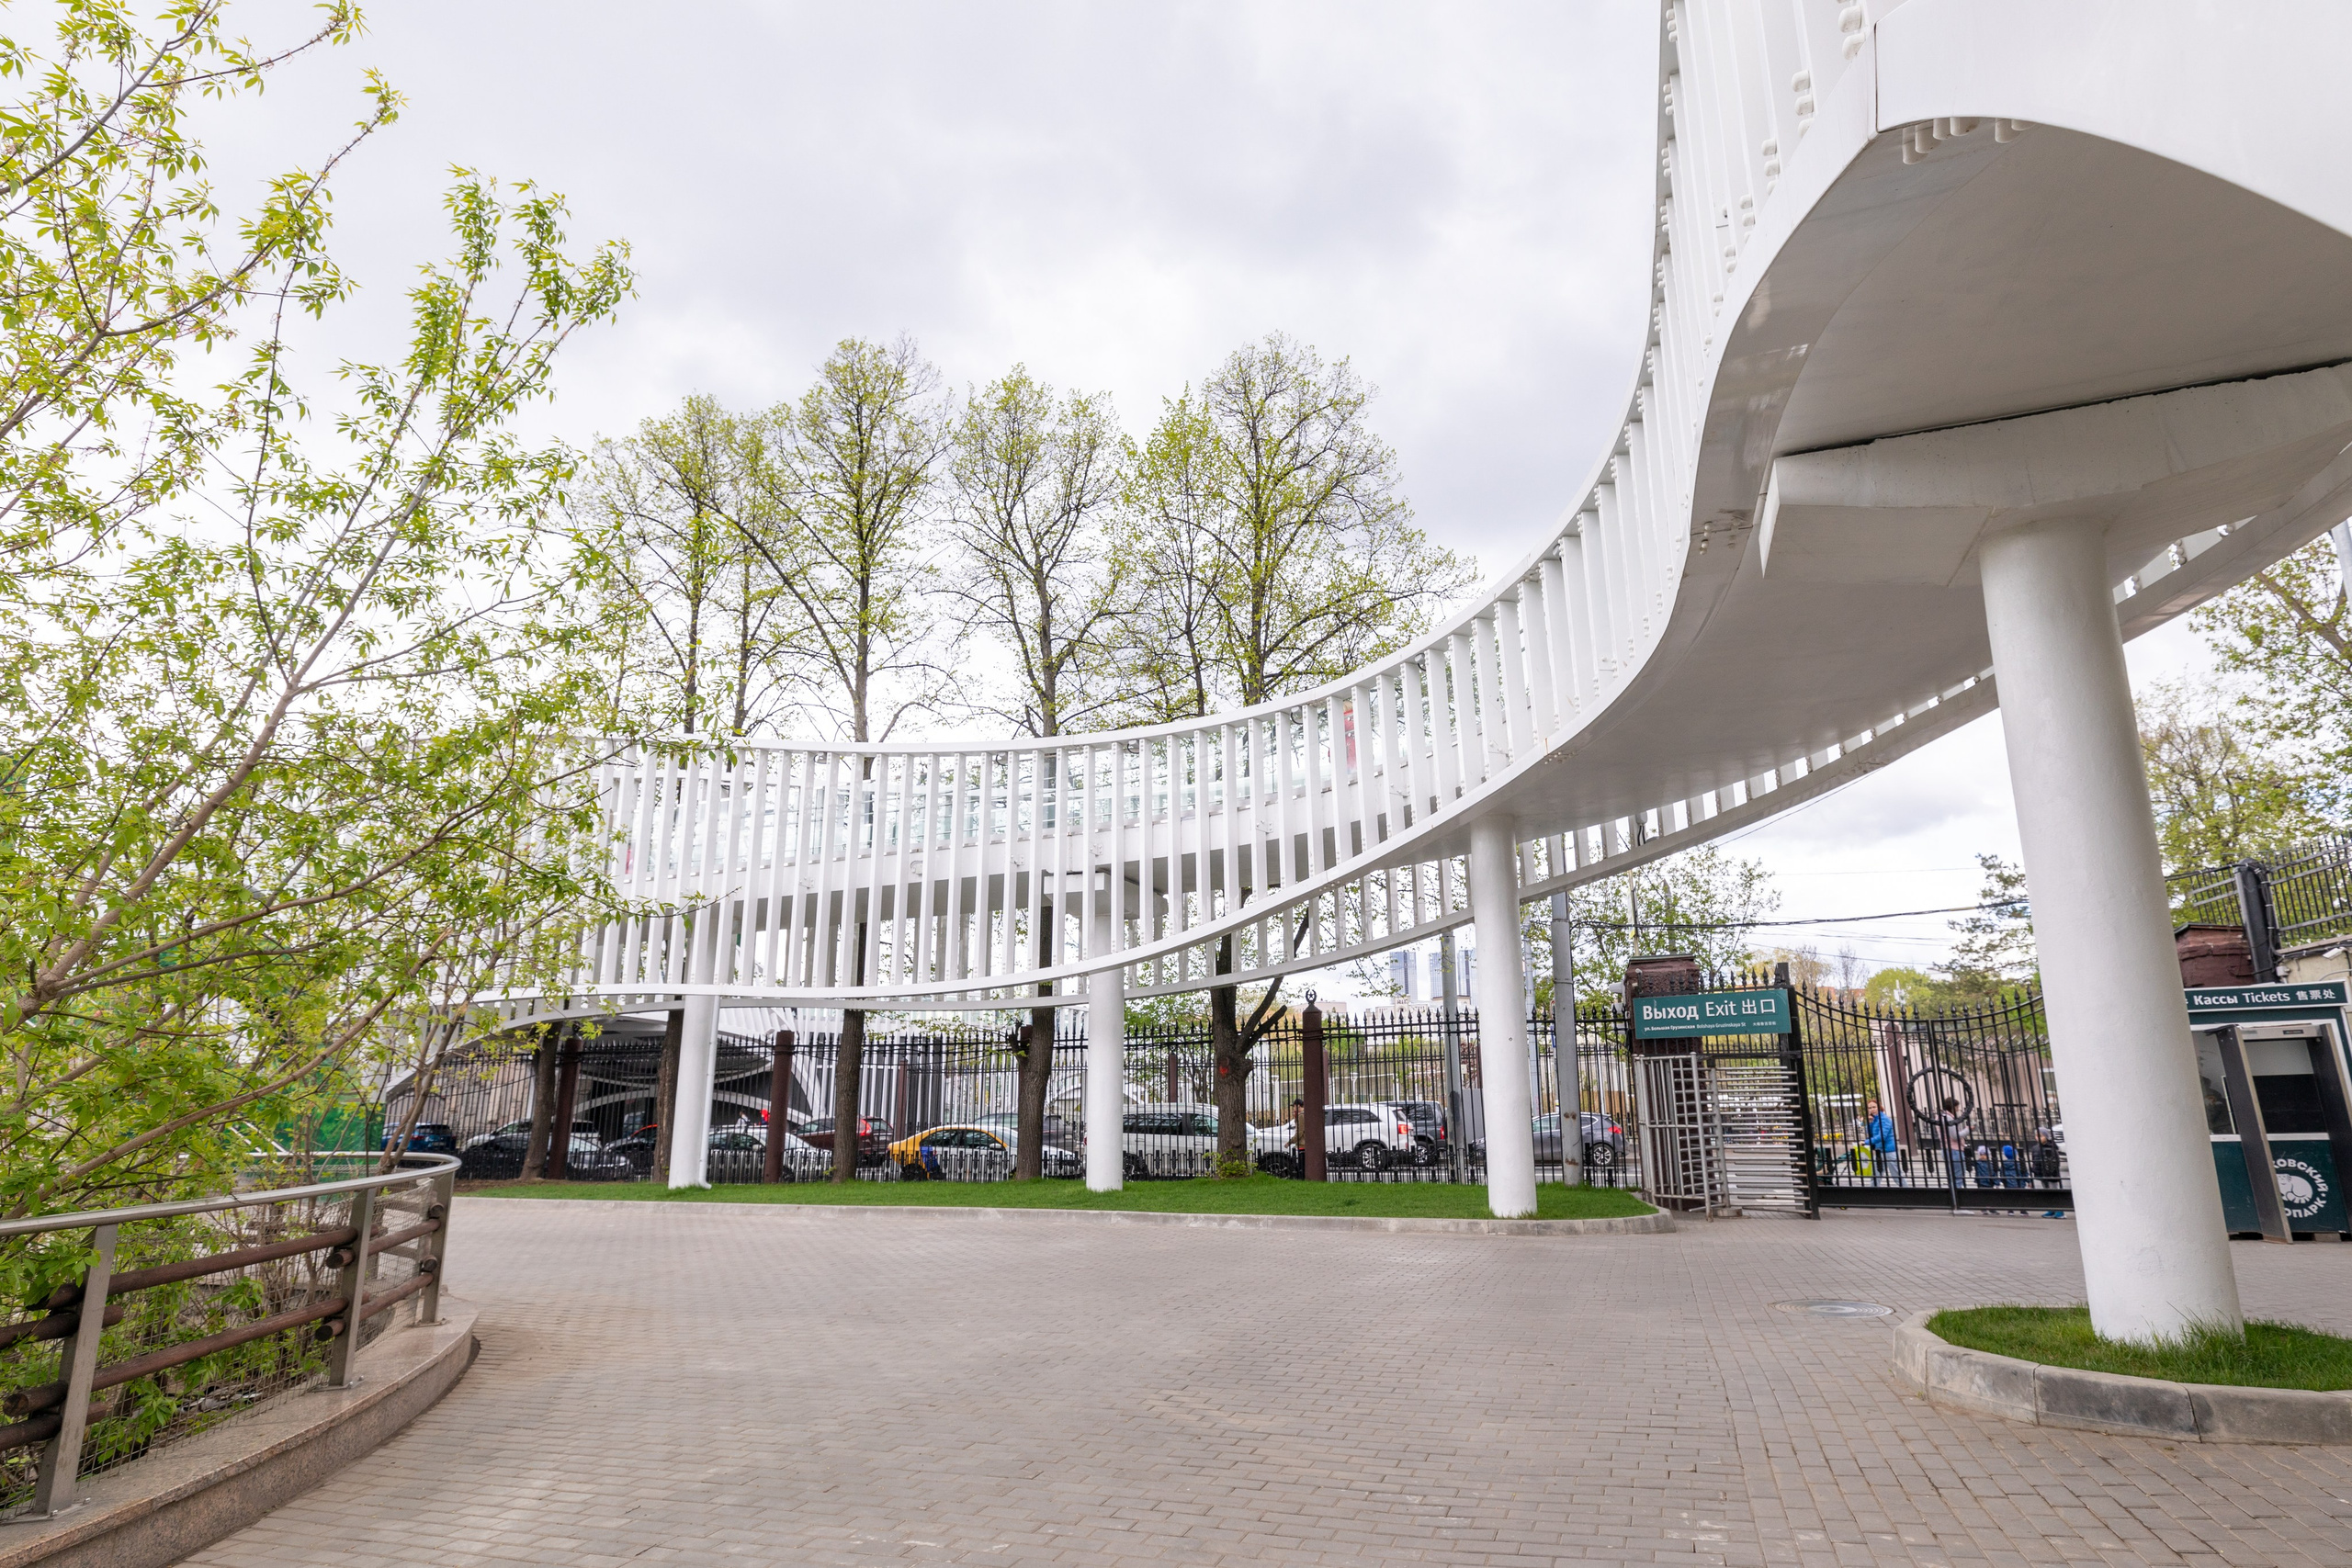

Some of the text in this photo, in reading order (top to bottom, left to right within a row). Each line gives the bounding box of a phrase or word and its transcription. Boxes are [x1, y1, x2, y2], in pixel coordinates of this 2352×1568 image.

[2193, 988, 2336, 1005] Кассы Tickets 售票处
[1643, 998, 1776, 1021] Выход Exit 出口
[2284, 1197, 2327, 1218] ОПАРК
